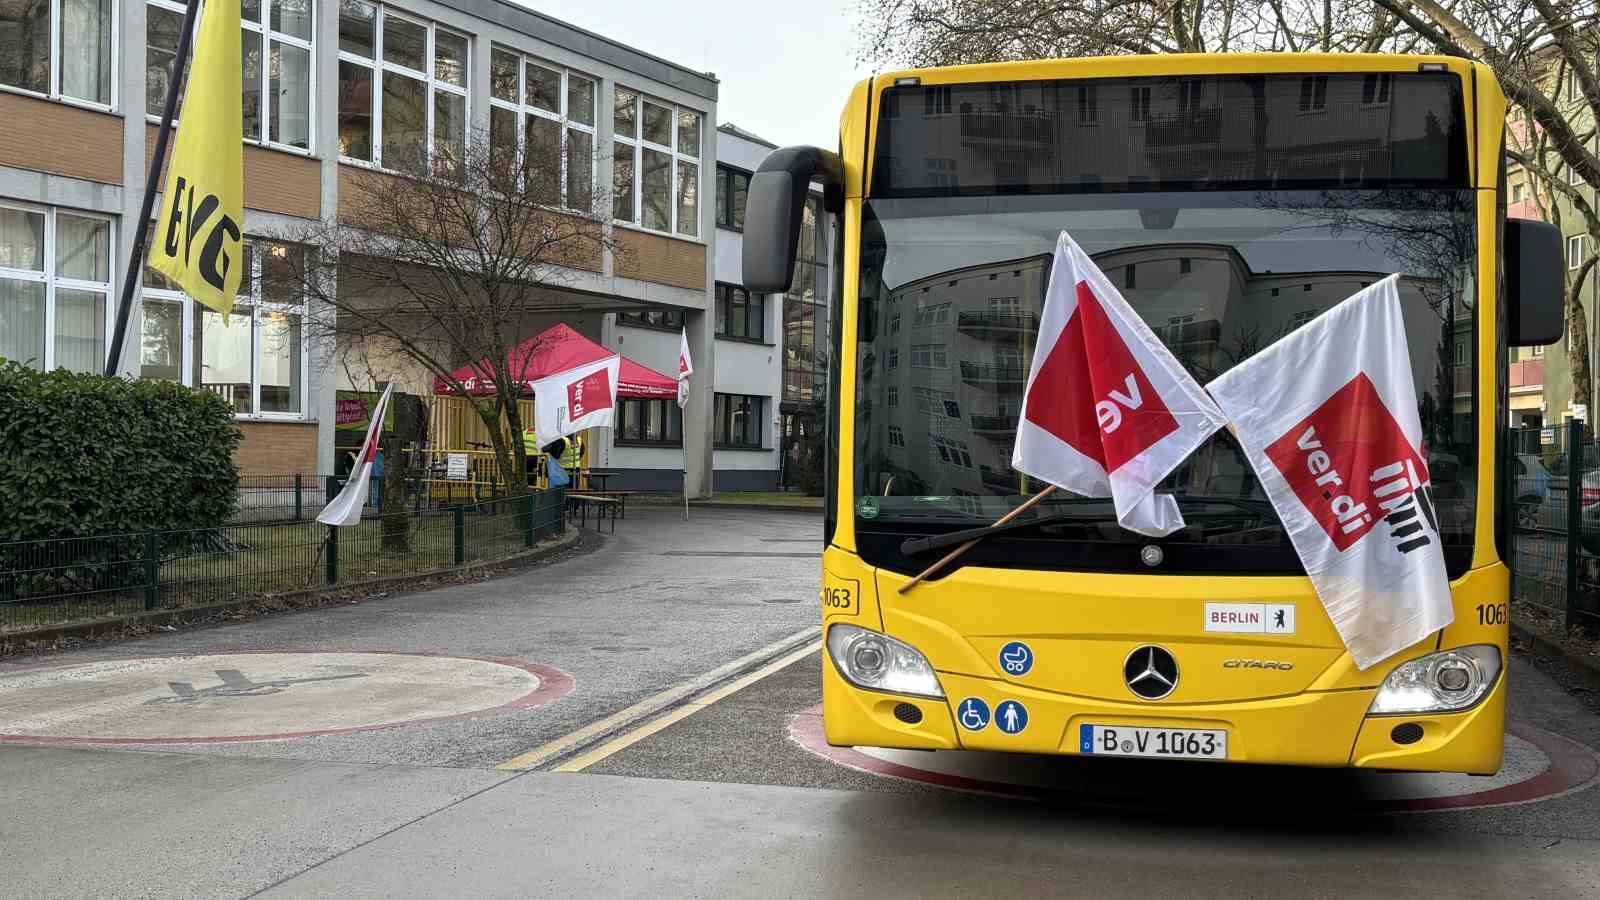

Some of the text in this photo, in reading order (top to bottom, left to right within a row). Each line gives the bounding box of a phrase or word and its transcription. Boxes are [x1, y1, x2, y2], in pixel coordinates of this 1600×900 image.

[1296, 425, 1373, 535] ver.di
[1211, 611, 1259, 624] BERLIN
[1223, 660, 1294, 671] CITARO
[1103, 729, 1118, 751] B
[1155, 731, 1216, 755] 1063
